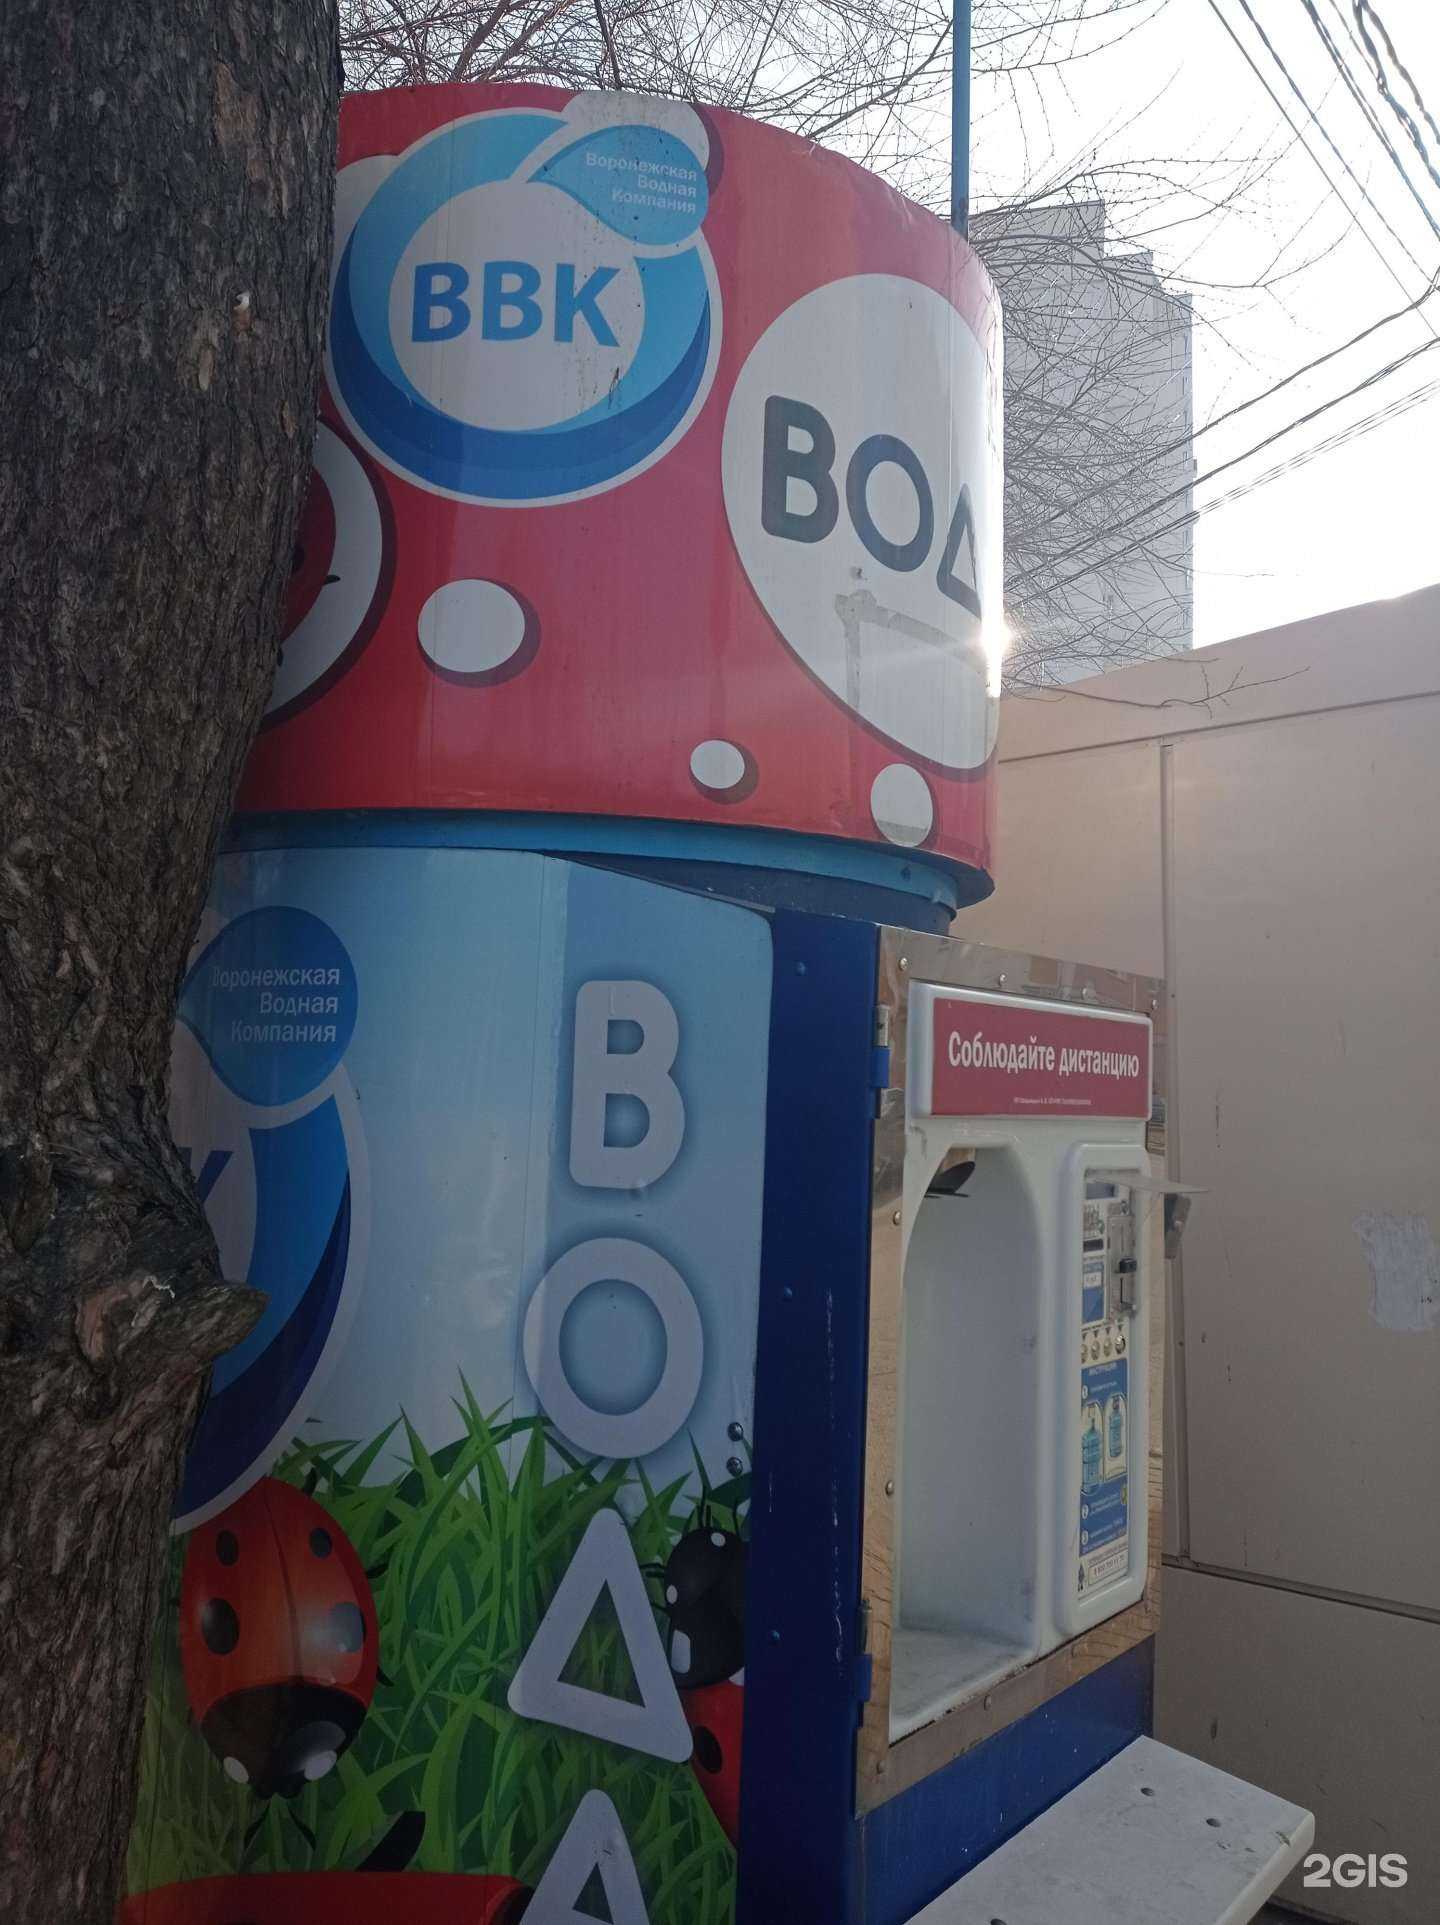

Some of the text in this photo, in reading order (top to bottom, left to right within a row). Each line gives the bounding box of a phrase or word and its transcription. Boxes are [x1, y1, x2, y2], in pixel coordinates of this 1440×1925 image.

[586, 152, 697, 182] Воронежская
[638, 174, 697, 198] Водная
[612, 188, 697, 214] Компания
[412, 261, 621, 347] ВВК
[260, 992, 338, 1016] Водная
[232, 1020, 337, 1043] Компания
[949, 1031, 1139, 1080] Соблюдайте дистанцию
